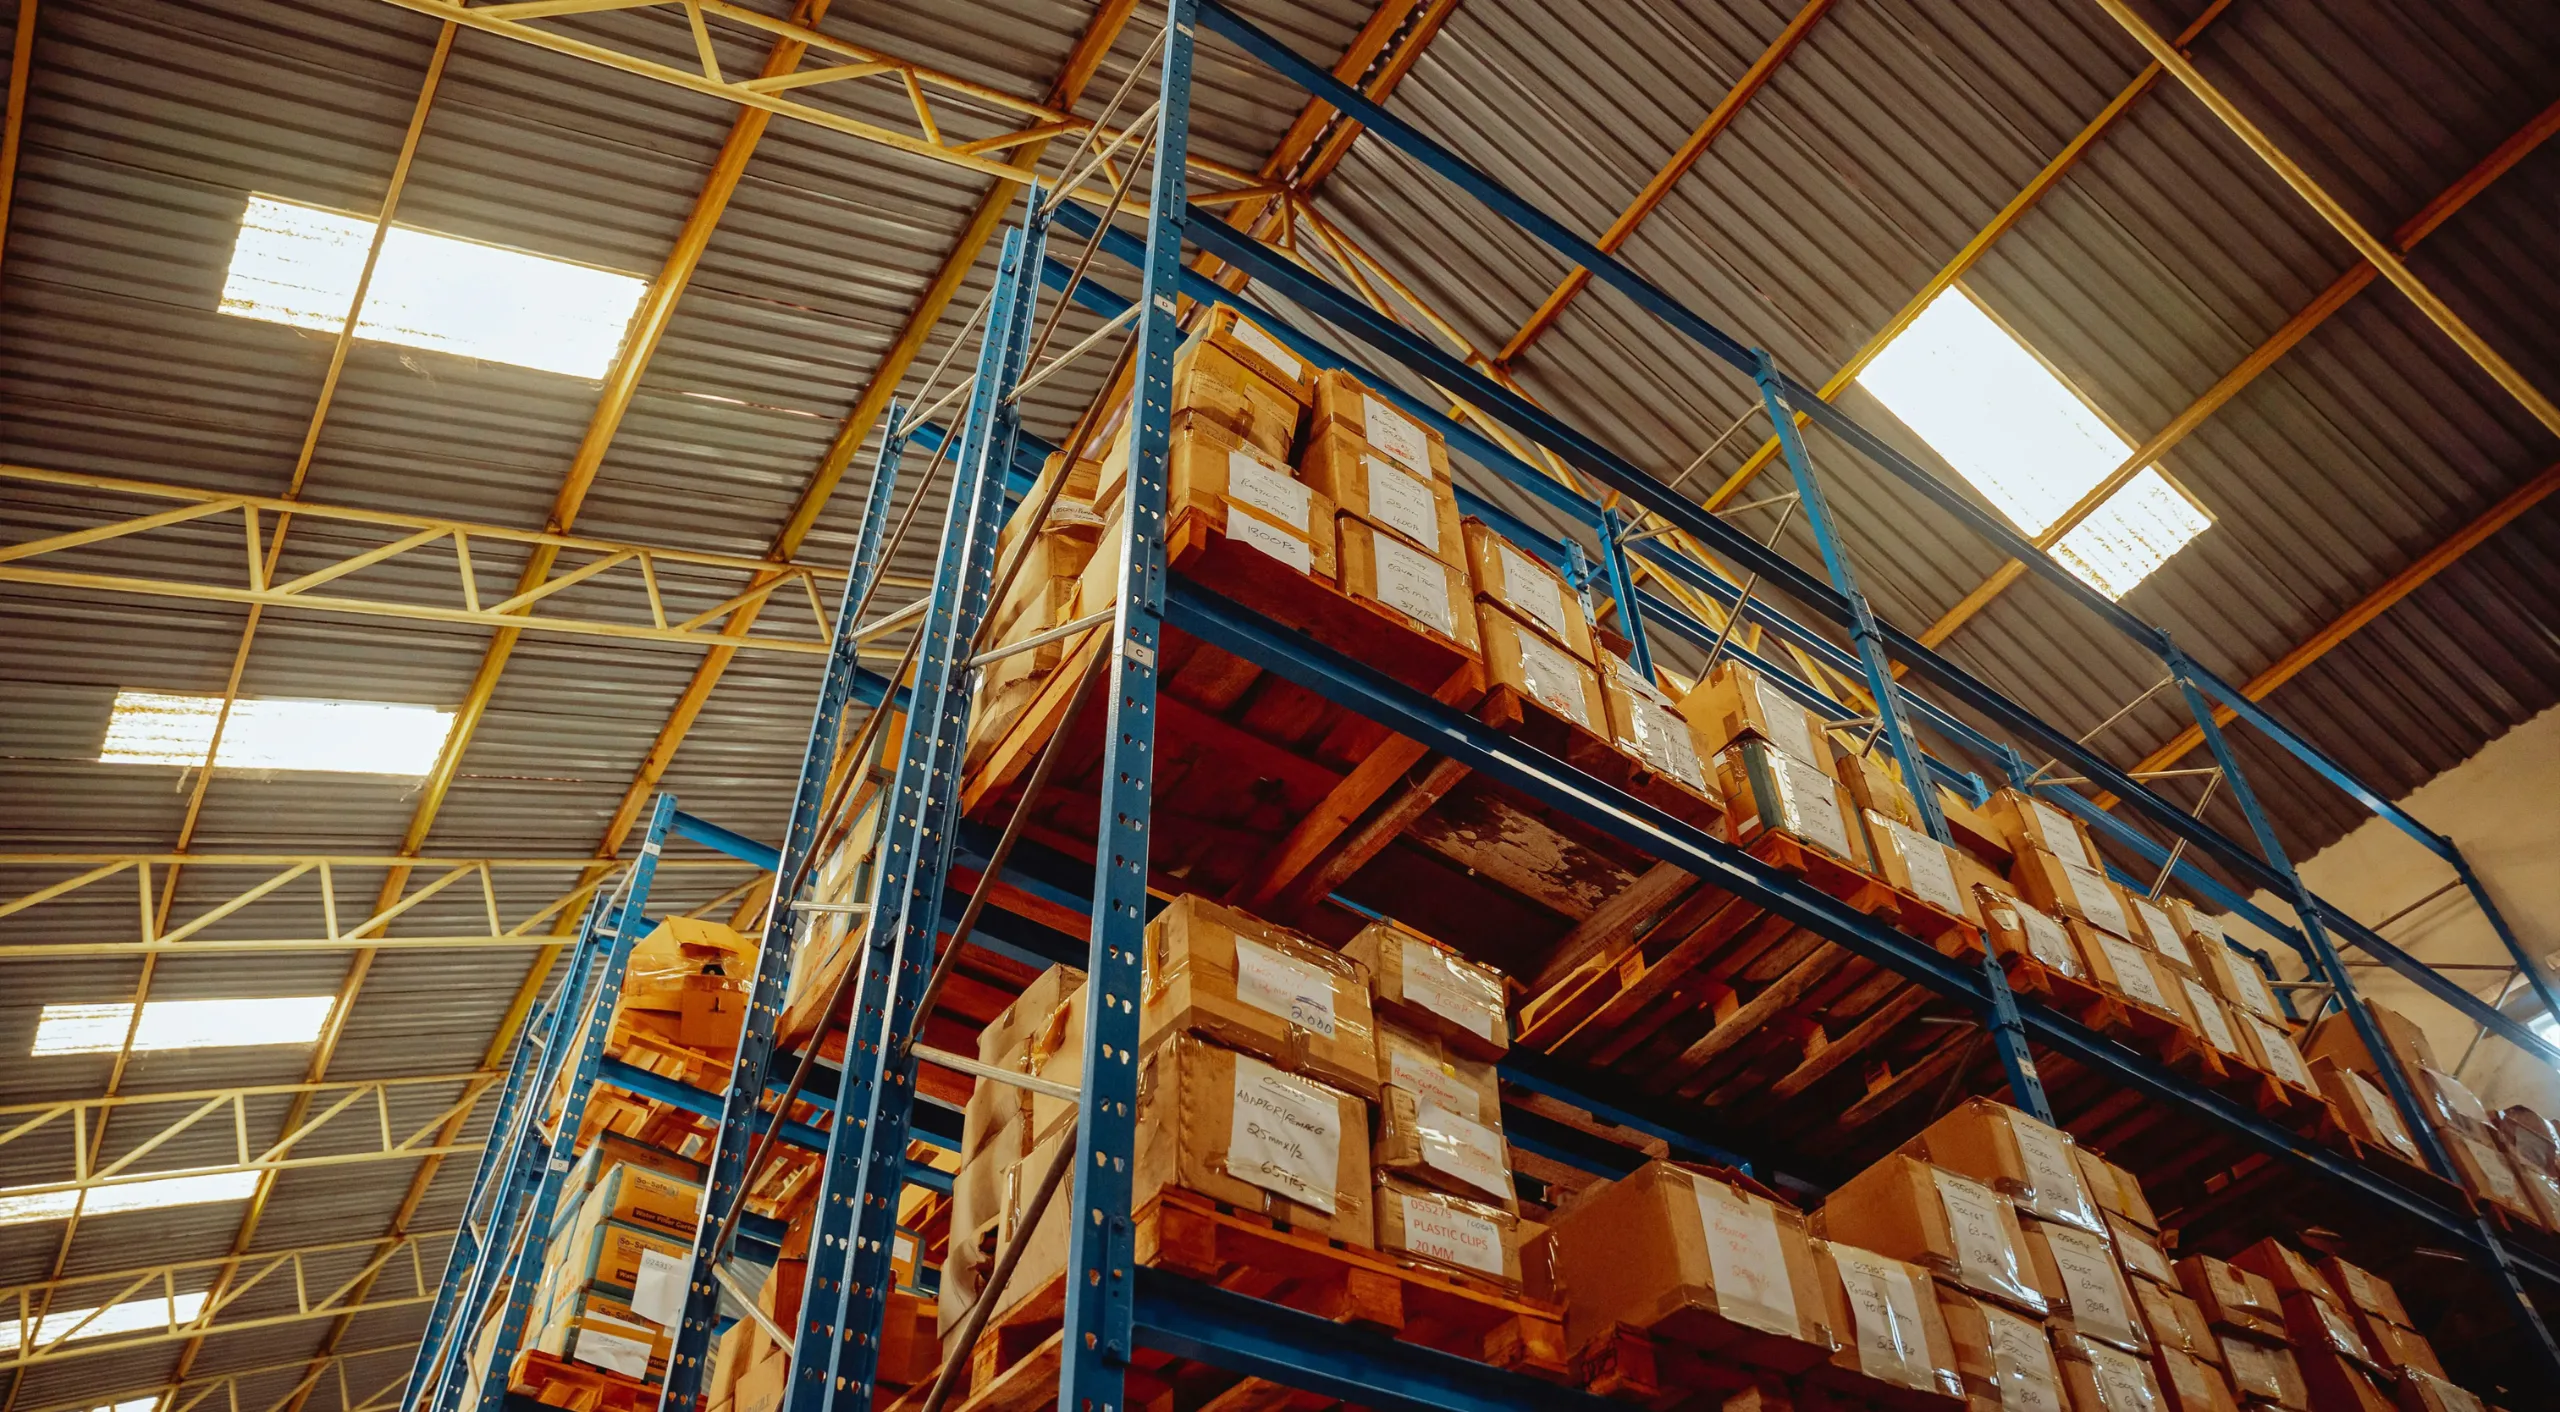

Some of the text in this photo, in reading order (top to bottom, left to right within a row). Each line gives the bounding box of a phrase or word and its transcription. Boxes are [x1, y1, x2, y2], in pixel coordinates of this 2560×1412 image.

[1136, 649, 1143, 657] C
[1291, 1005, 1333, 1034] 2000
[636, 1176, 668, 1191] So-Safe
[676, 1219, 698, 1233] Cartri
[1414, 1219, 1489, 1250] PLASTIC CLIPS
[1416, 1240, 1454, 1261] 20 MM
